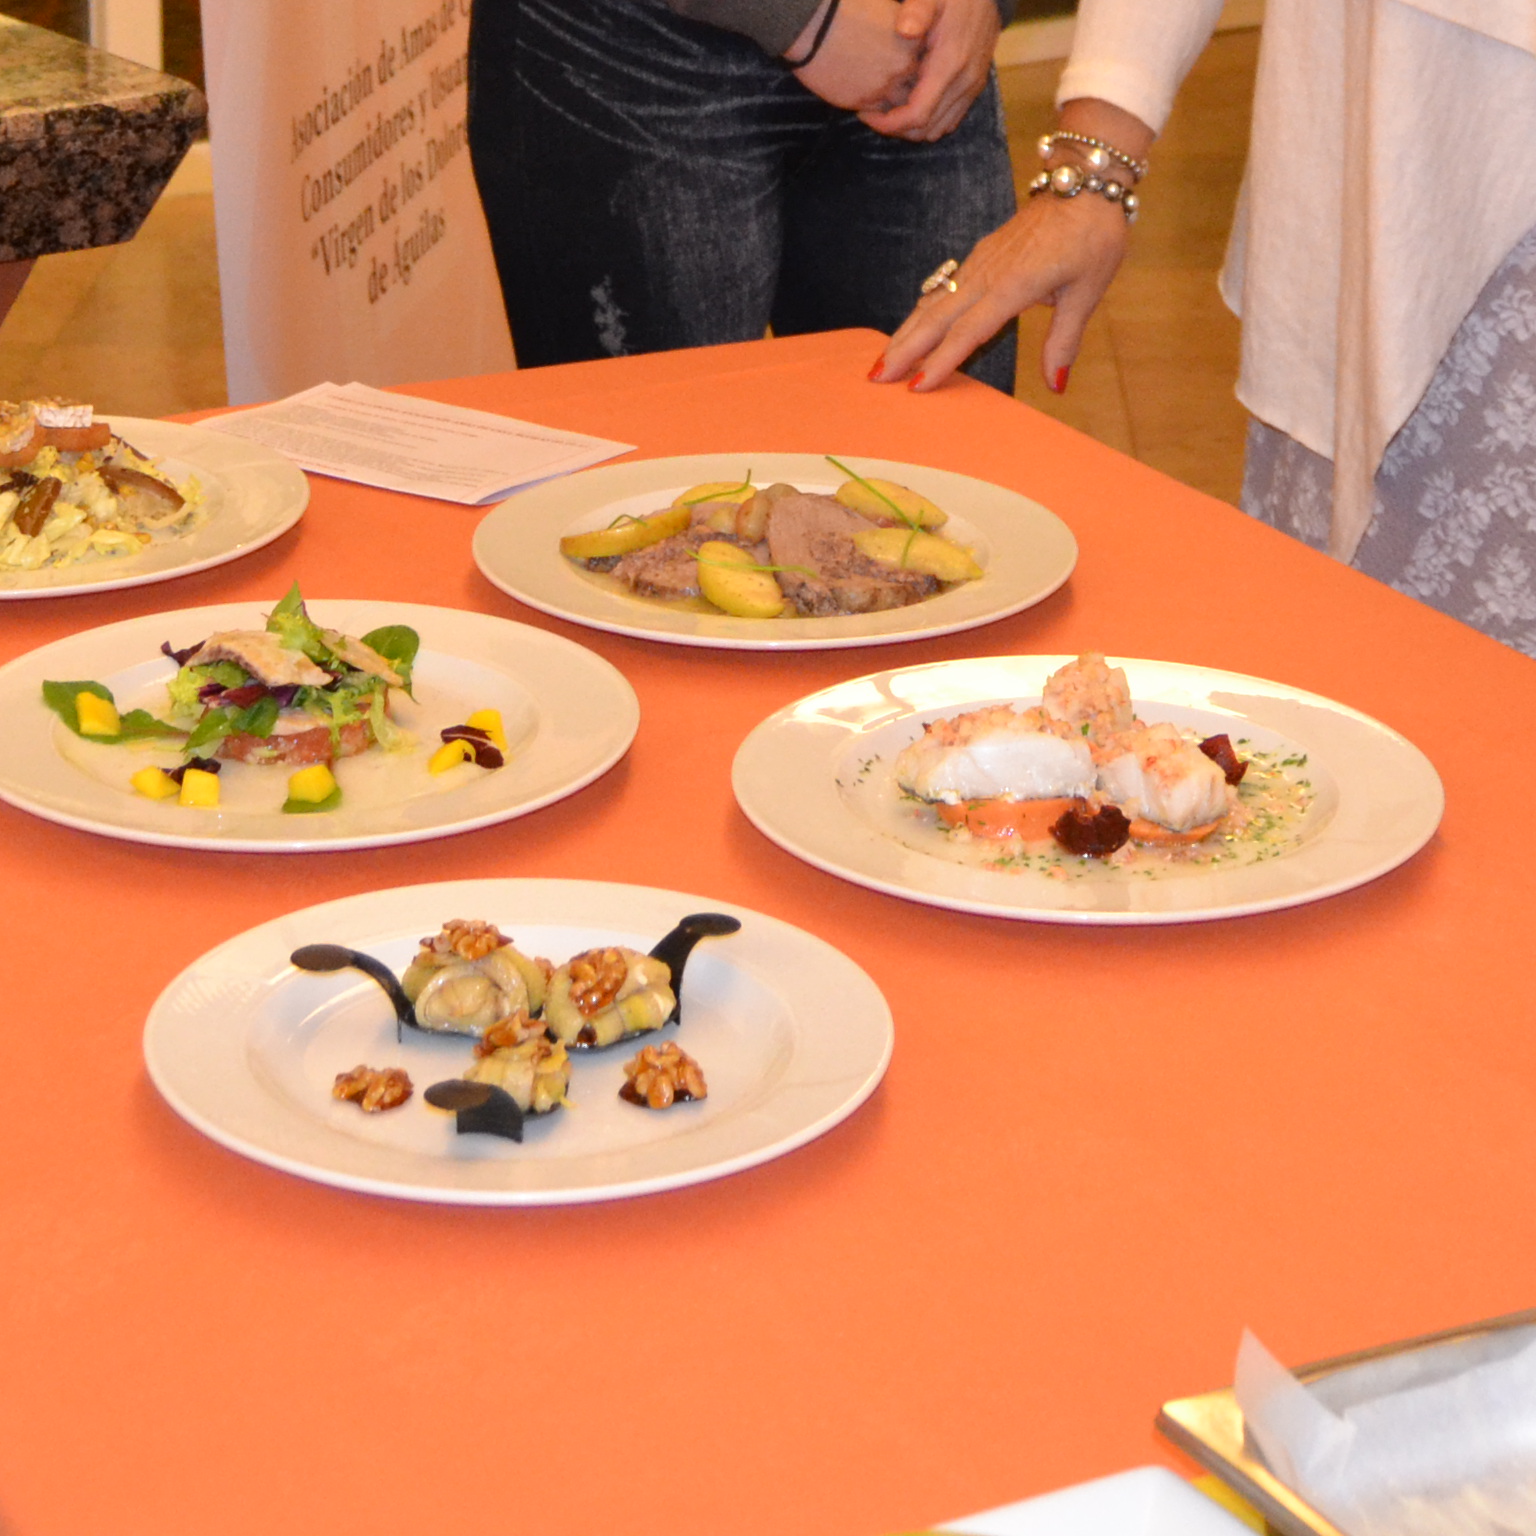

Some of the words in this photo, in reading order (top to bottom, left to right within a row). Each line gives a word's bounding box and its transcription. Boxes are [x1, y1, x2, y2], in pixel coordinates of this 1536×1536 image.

[377, 38, 396, 86] de
[400, 14, 438, 69] Amas
[300, 99, 415, 223] Consumidores
[379, 176, 398, 225] de
[401, 160, 423, 206] los
[368, 255, 389, 305] de
